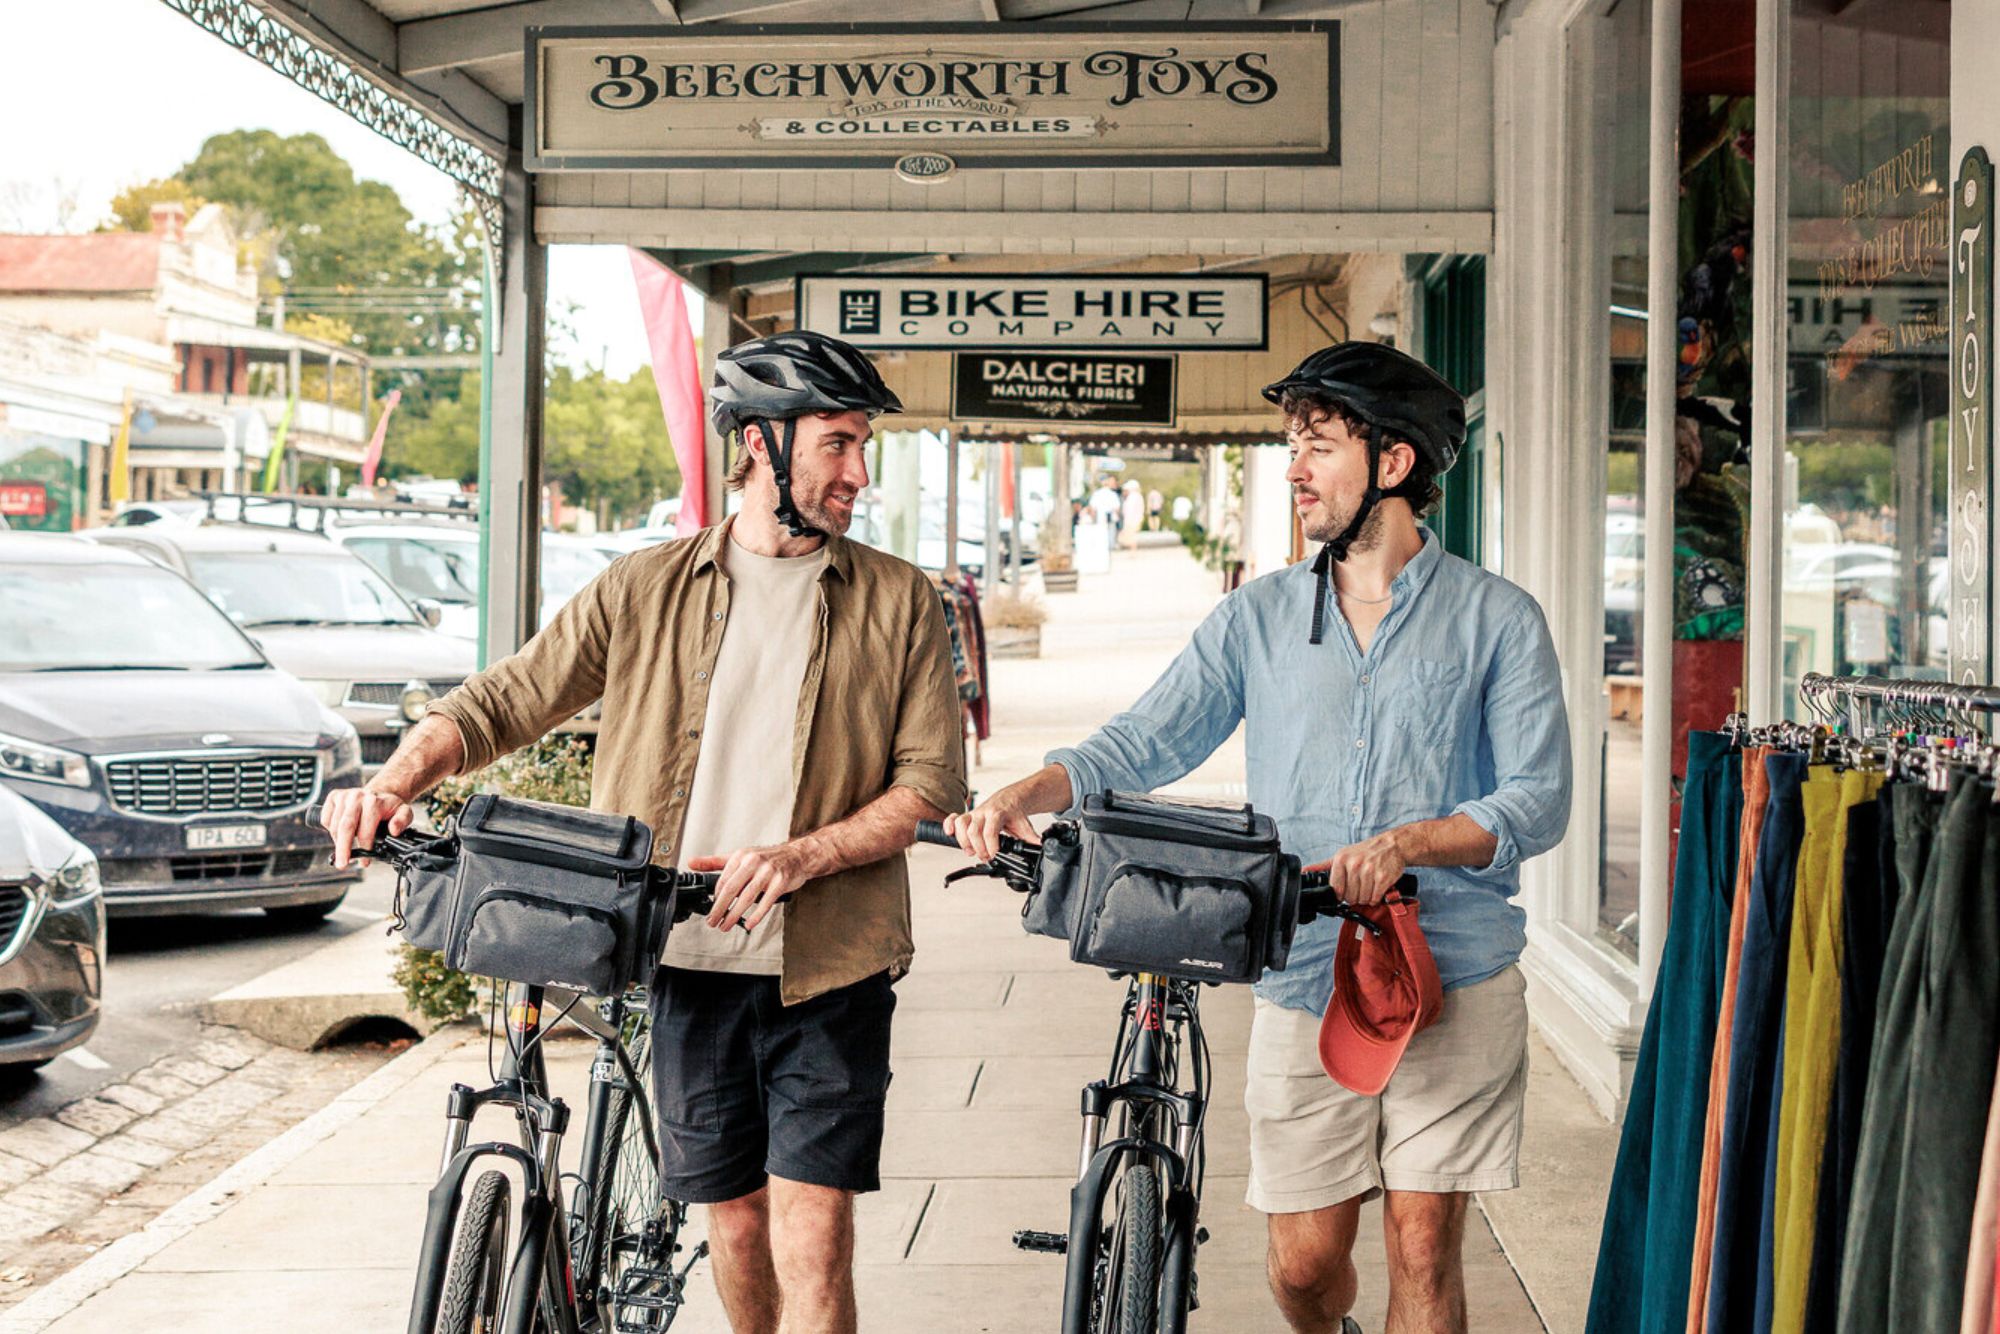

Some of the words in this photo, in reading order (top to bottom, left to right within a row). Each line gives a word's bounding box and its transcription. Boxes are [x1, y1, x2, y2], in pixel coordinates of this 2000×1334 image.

[590, 54, 1071, 110] BEECHWORTH
[1083, 47, 1279, 105] TOYS
[850, 101, 887, 116] TOYS
[893, 99, 908, 109] OF
[909, 97, 945, 108] THE
[949, 98, 1009, 115] WORLD
[785, 121, 806, 134] &
[815, 118, 1071, 134] COLLECTABLES
[1841, 135, 1933, 225] BEECHWORTH
[846, 294, 875, 328] THE
[900, 290, 1049, 318] BIKE
[1074, 290, 1225, 318] HIRE
[900, 320, 1225, 336] COMPANY
[1957, 222, 1982, 472] TOY
[982, 358, 1146, 385] DALCHERI
[991, 384, 1071, 399] NATURAL
[1077, 386, 1136, 401] FIBRES
[1959, 489, 1980, 734] SHO
